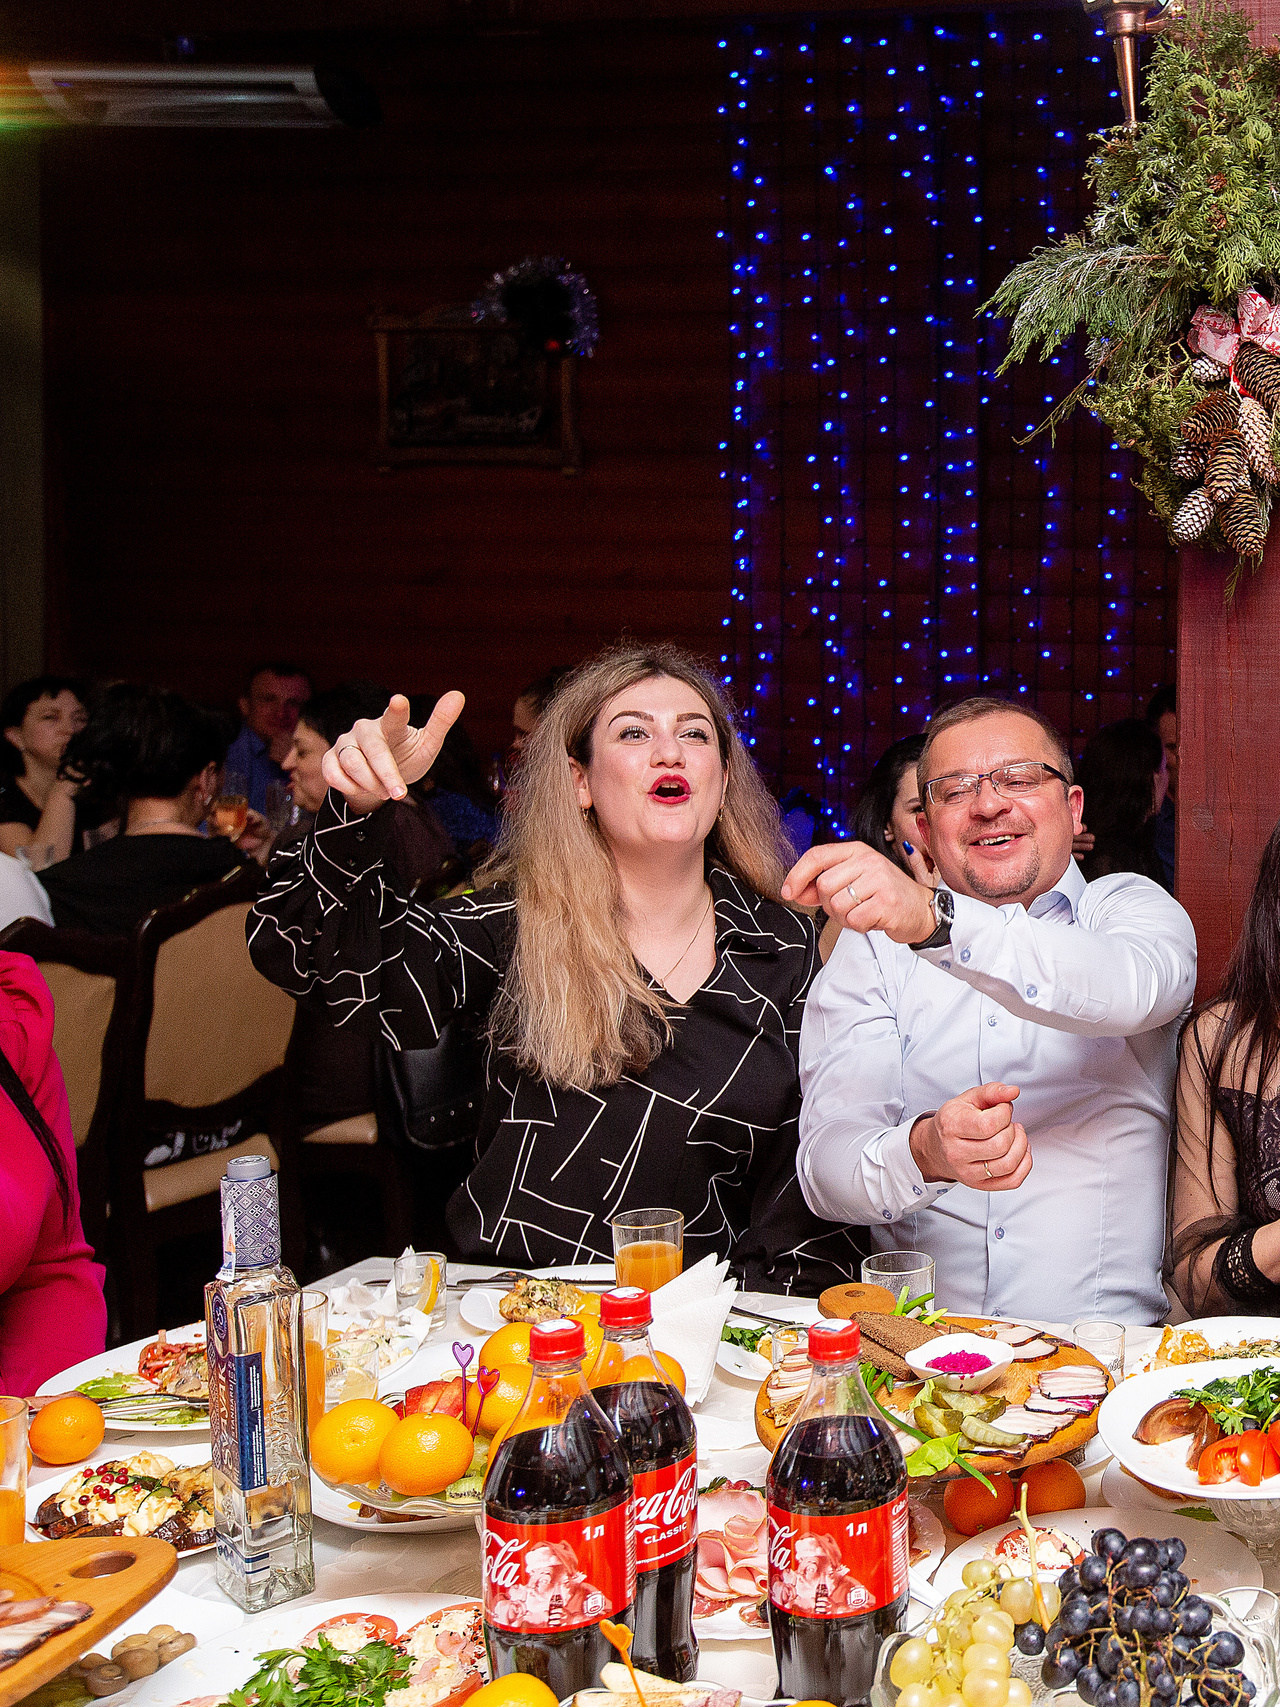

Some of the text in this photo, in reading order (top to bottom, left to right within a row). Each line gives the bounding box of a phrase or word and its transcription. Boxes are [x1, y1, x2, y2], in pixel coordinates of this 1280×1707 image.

[218, 1361, 233, 1471] SVAYAK
[582, 1524, 605, 1541] 1л
[643, 1521, 688, 1545] CLASSIC
[846, 1522, 868, 1537] 1л
